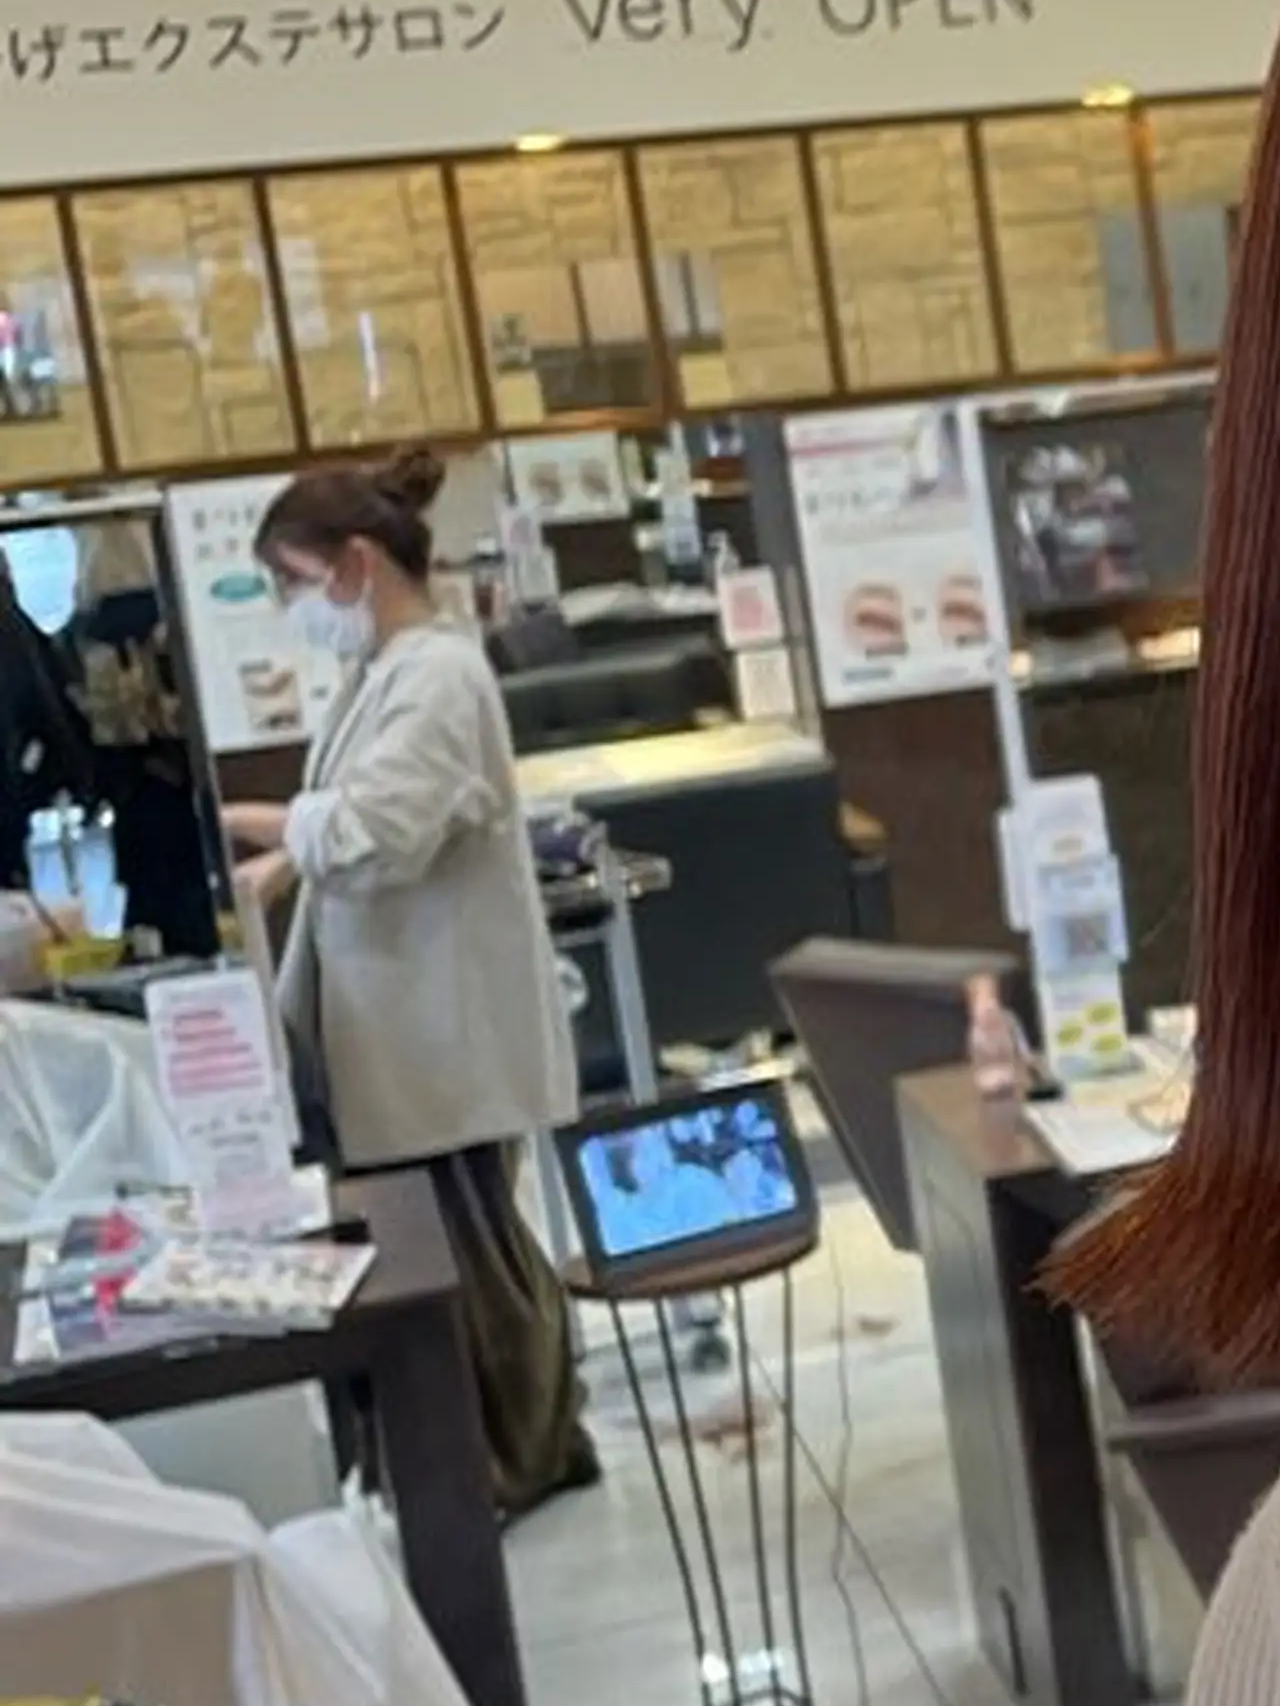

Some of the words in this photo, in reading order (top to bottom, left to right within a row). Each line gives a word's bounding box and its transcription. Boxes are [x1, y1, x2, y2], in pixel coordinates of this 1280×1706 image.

[0, 3, 505, 81] げエクステサロン
